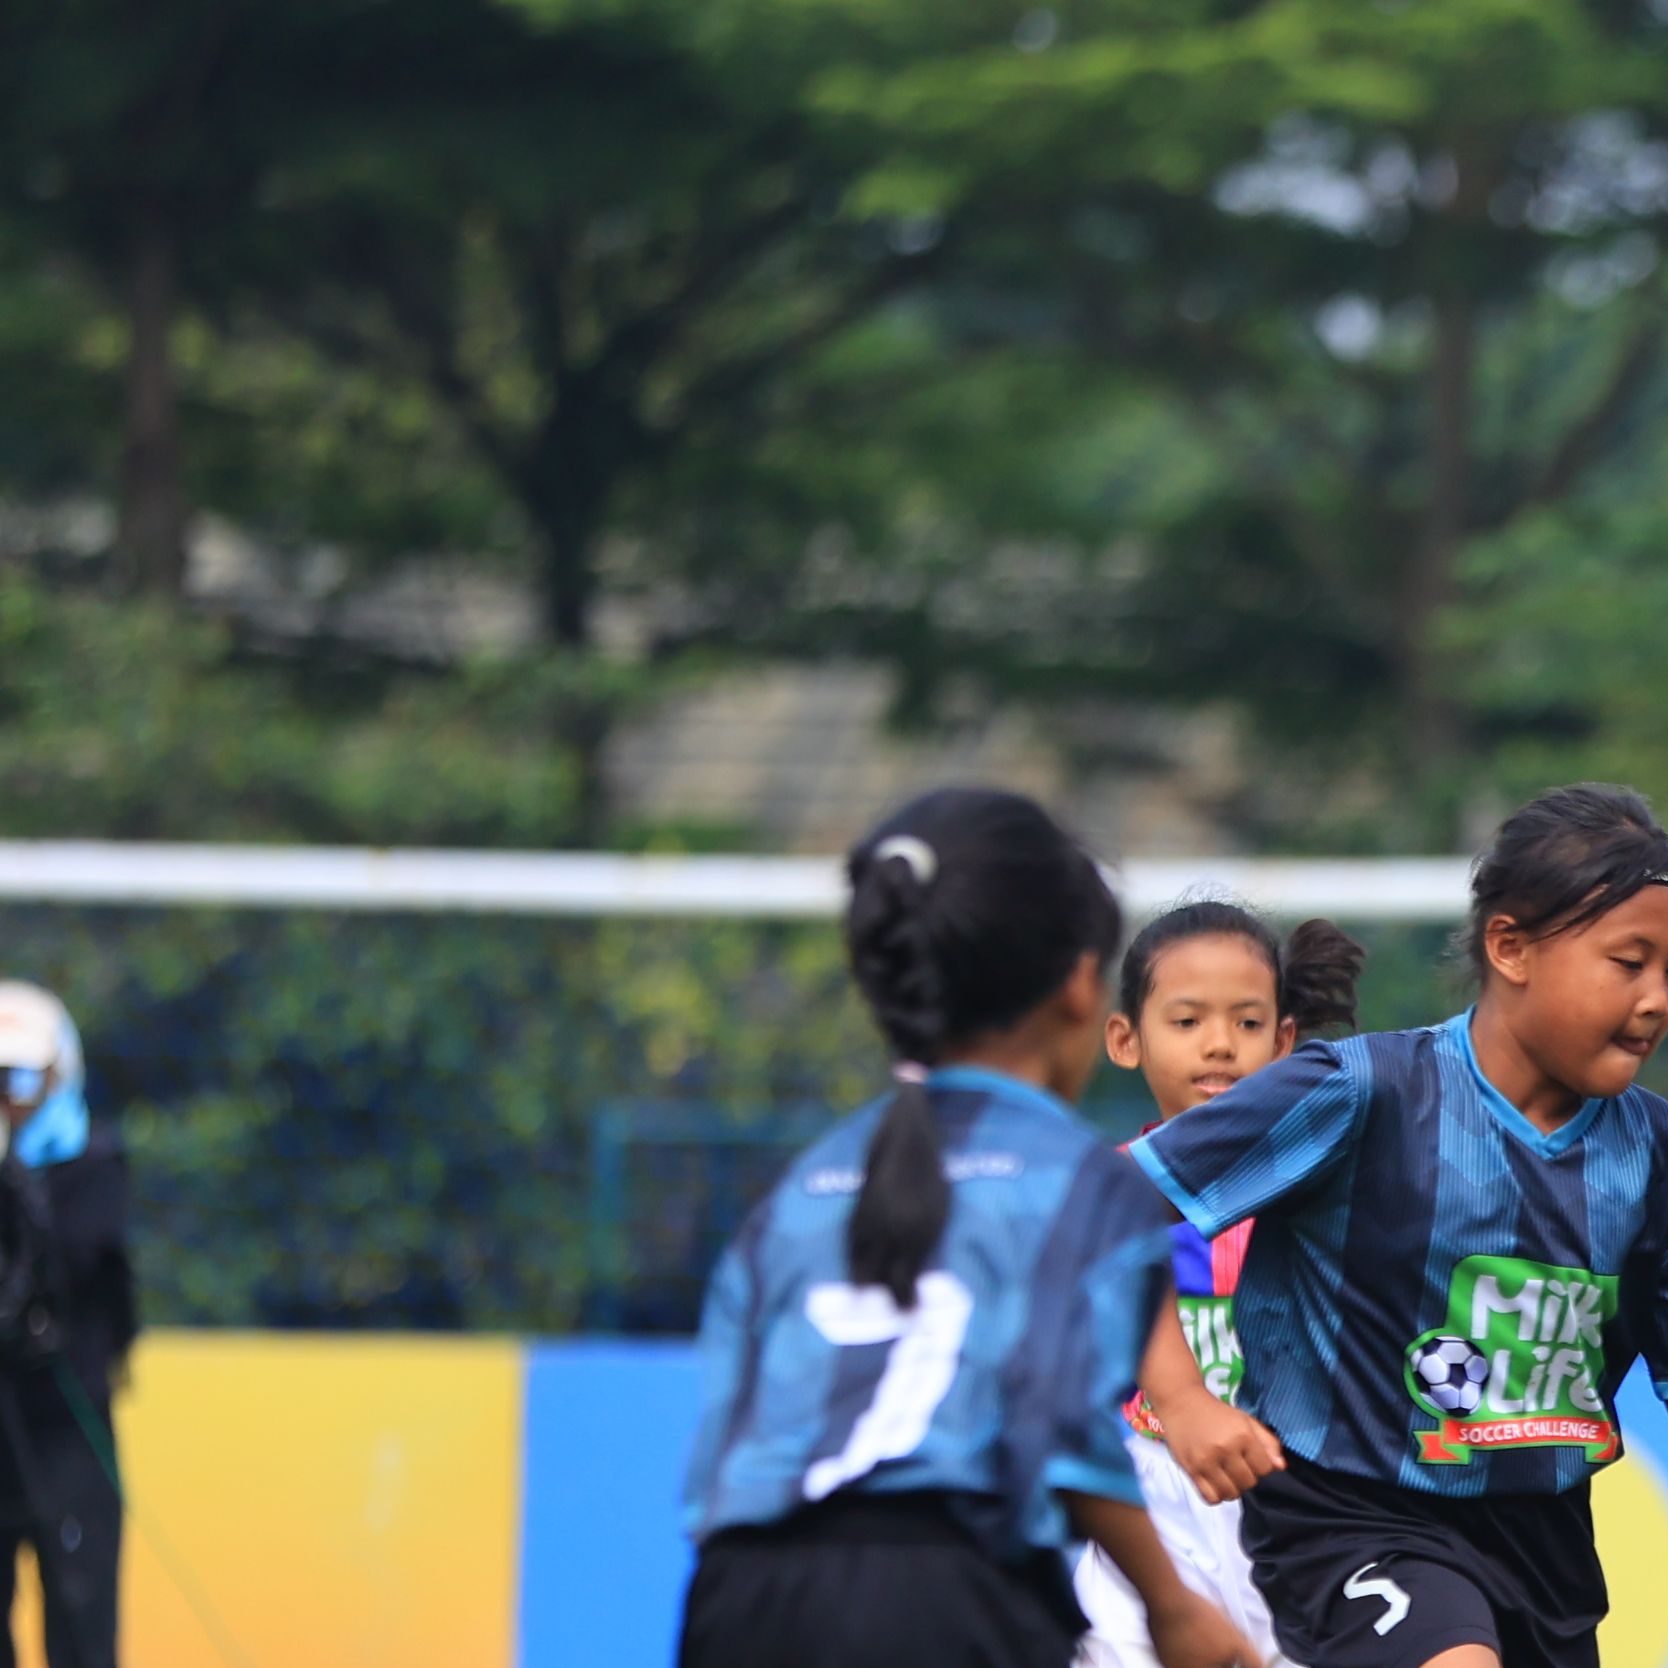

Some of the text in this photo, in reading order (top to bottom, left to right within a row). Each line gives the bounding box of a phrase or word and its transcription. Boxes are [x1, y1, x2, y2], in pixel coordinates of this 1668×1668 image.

[1178, 1306, 1244, 1371] ilk
[1471, 1275, 1602, 1348] Milk
[803, 1271, 974, 1500] 7
[1487, 1347, 1604, 1413] Life
[1459, 1421, 1600, 1443] SOCCER CHALLENGE
[1343, 1561, 1411, 1636] 5
